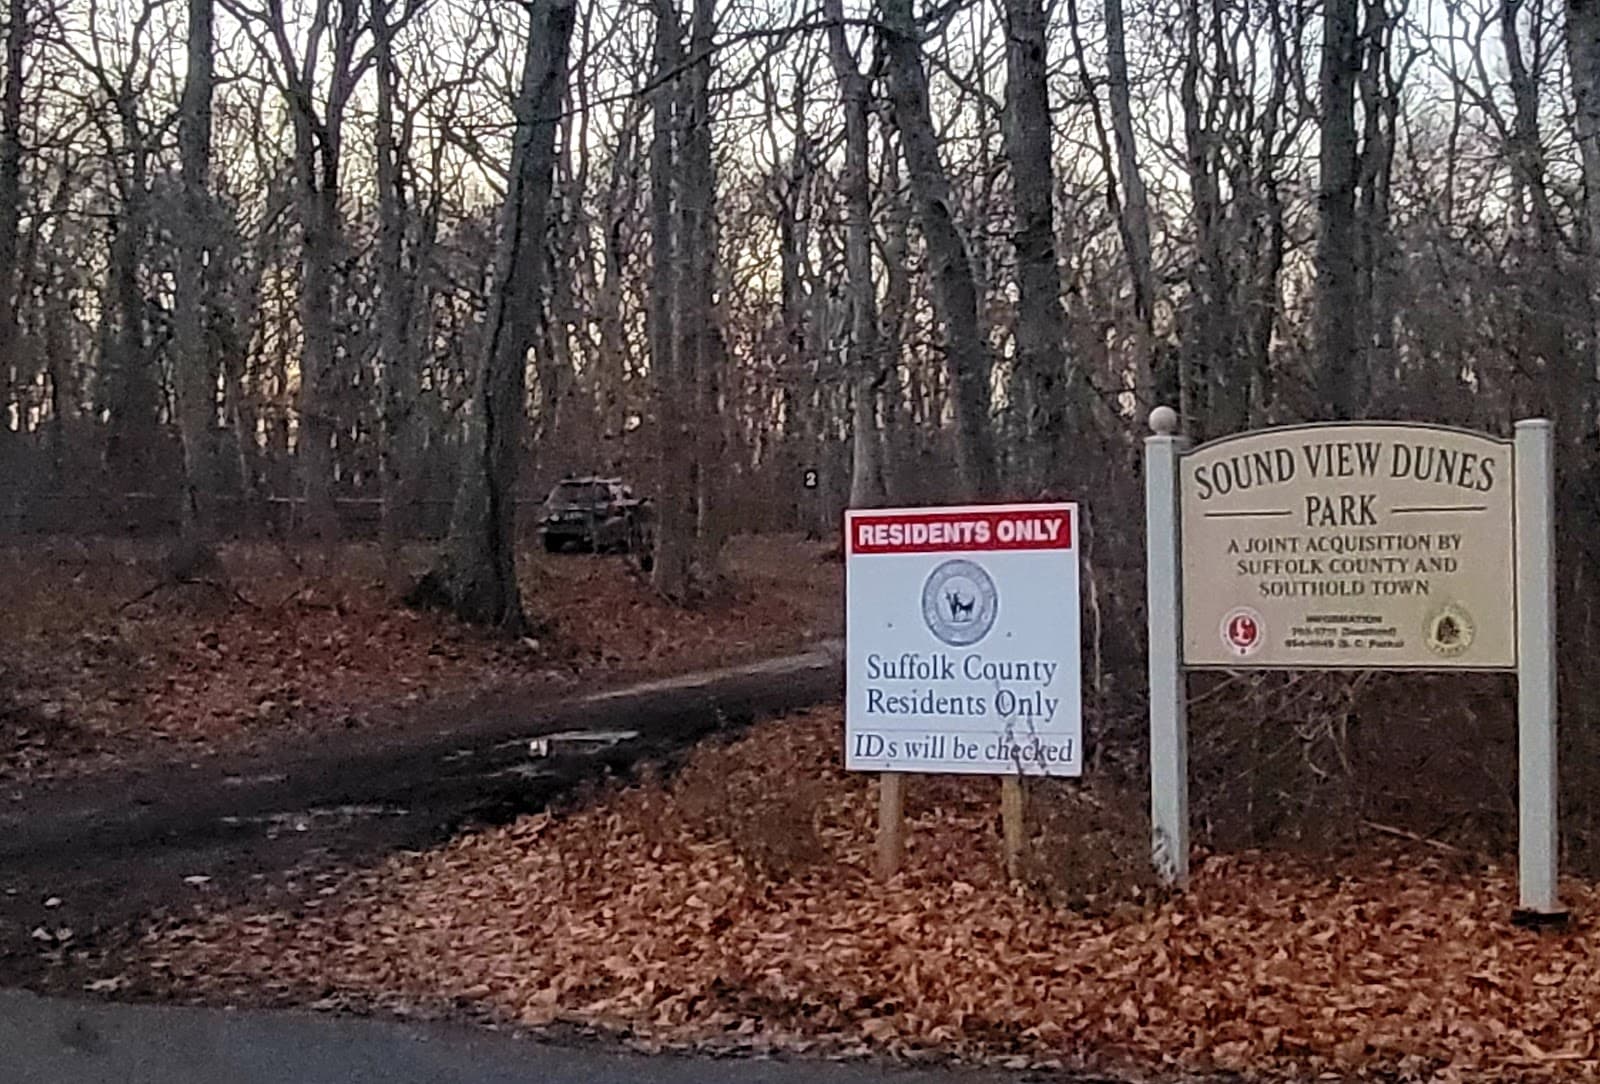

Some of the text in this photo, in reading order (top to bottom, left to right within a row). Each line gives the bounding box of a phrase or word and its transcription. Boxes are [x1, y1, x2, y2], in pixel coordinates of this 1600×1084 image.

[806, 471, 816, 486] 2
[1194, 442, 1496, 500] SOUND VIEW DUNES
[1305, 494, 1377, 527] PARK
[858, 518, 1063, 546] RESIDENTS ONLY
[1227, 534, 1461, 554] A JOINT ACQUISITION BY
[1237, 556, 1457, 575] SUFFOLK COUNTY AND
[1260, 579, 1429, 597] SOUTHOLD TOWN
[867, 654, 1058, 687] Suffolk County
[866, 688, 1059, 723] Residents Only
[855, 733, 1073, 763] IDs will be checked
